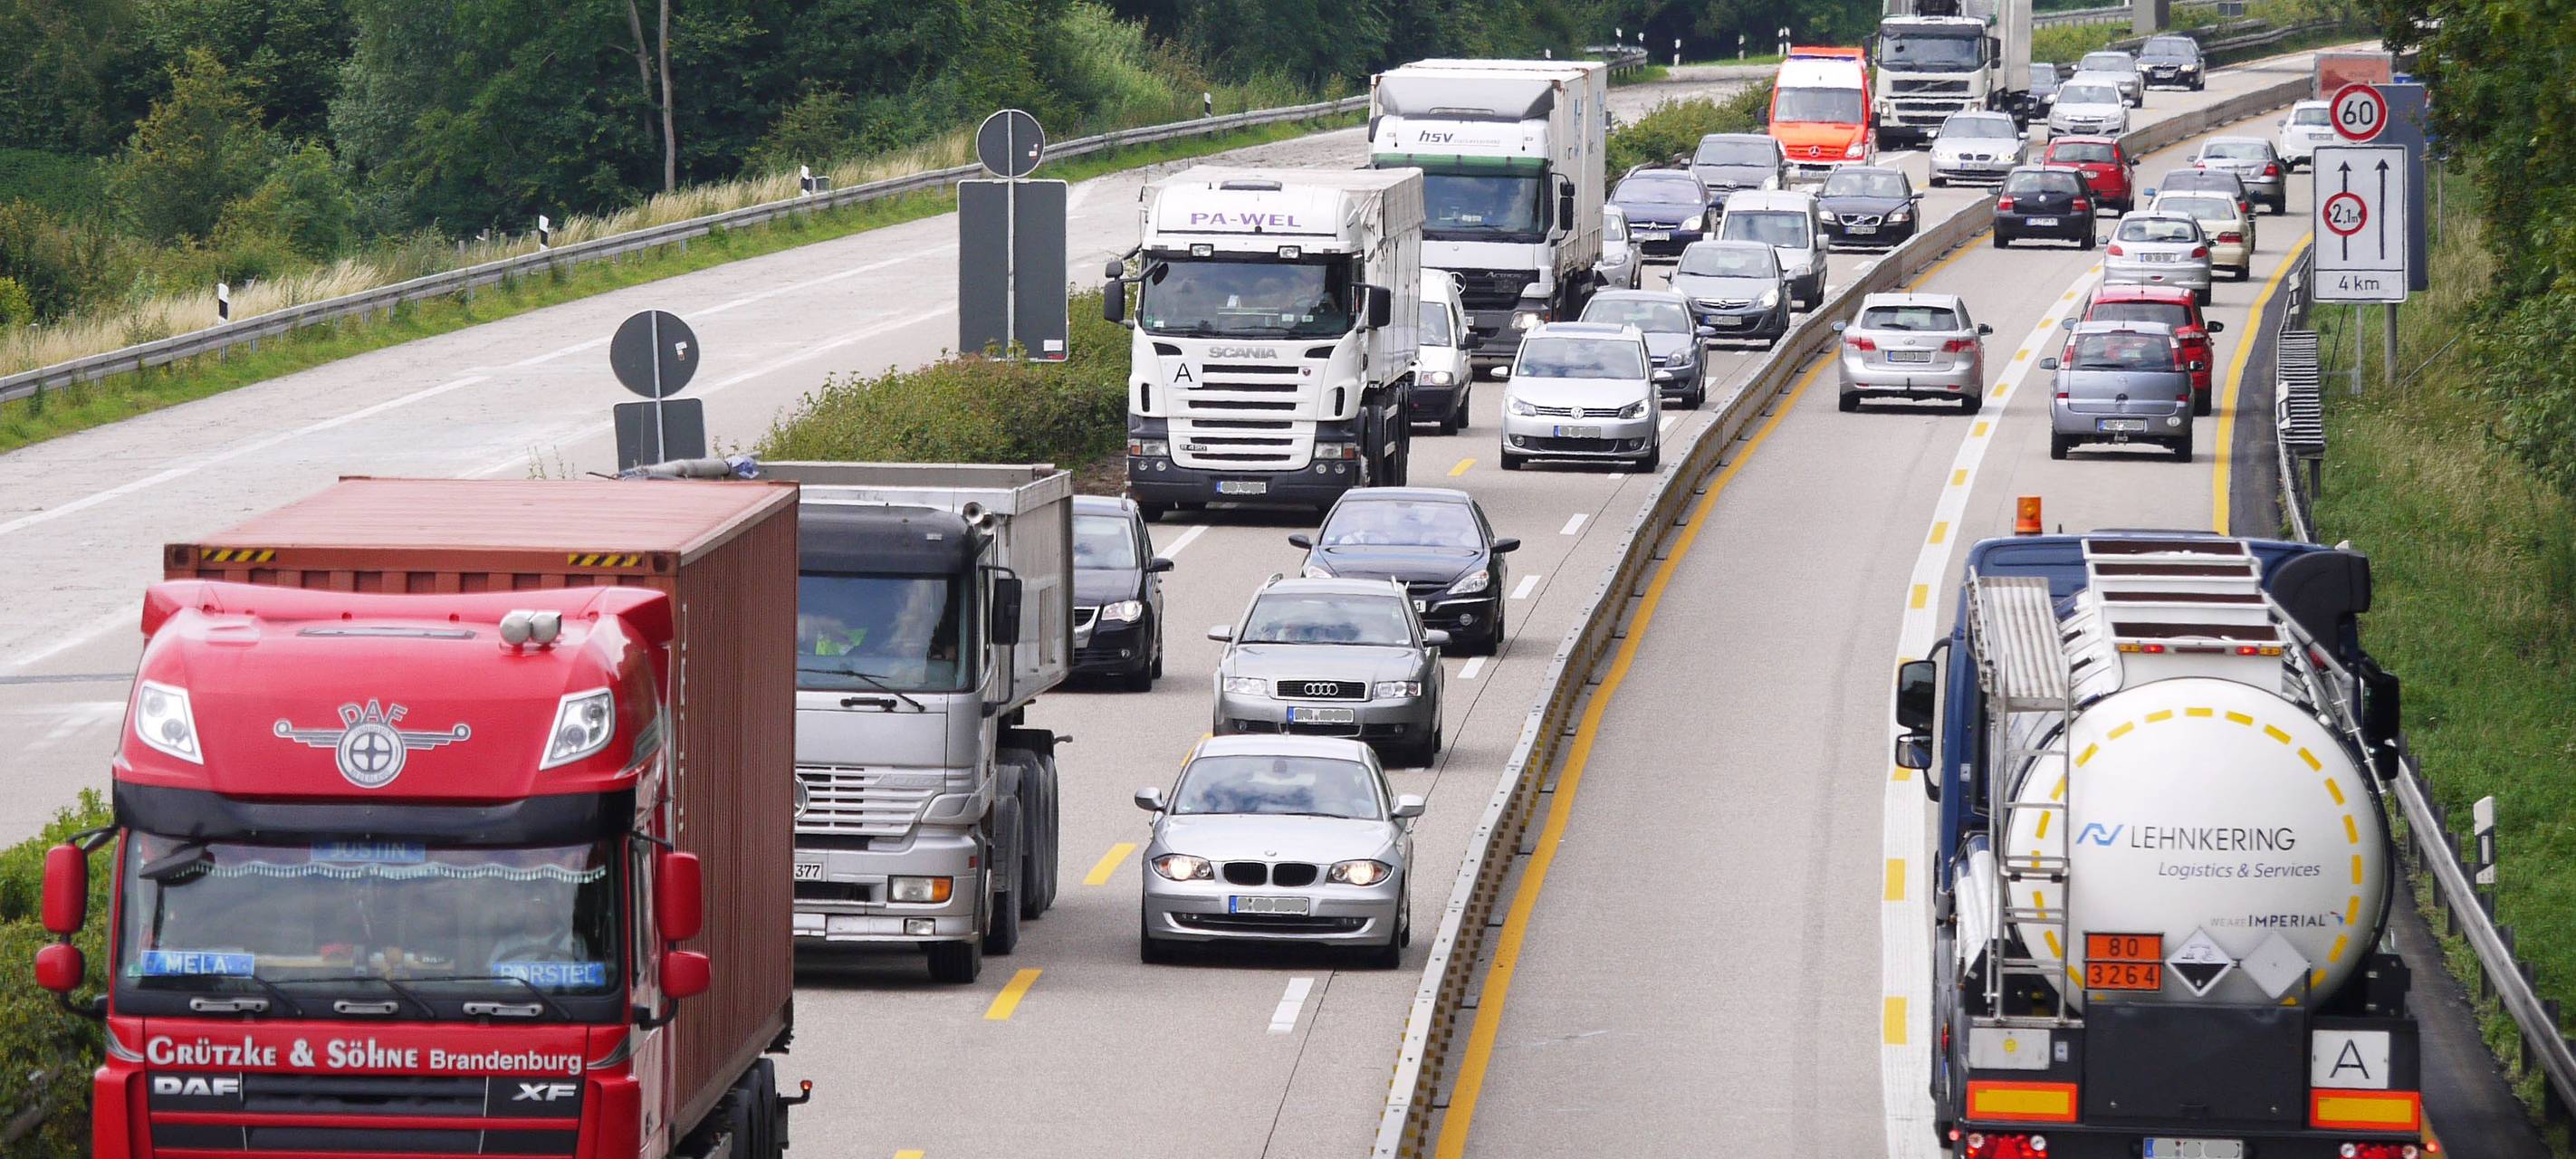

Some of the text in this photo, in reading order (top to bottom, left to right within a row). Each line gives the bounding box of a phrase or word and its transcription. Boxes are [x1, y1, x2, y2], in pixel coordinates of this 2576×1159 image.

[2342, 101, 2373, 125] 60
[1418, 129, 1454, 143] hsv
[1191, 213, 1302, 227] PA-WEL
[2339, 275, 2380, 291] 4 km
[1208, 346, 1278, 359] SCANIA
[1173, 362, 1193, 383] A
[338, 698, 409, 730] DAF
[2131, 825, 2296, 851] LEHNKERING
[795, 864, 821, 878] 377
[2159, 862, 2322, 880] Logistics & Services
[2248, 914, 2326, 927] IMPERIAL
[2109, 937, 2140, 957] 80
[165, 953, 227, 975] MELA
[2090, 965, 2156, 985] 3264
[289, 1038, 316, 1068] &
[429, 1048, 582, 1076] Brandenburg
[2328, 1039, 2370, 1080] A
[154, 1076, 240, 1097] DAF
[511, 1082, 578, 1102] XF
